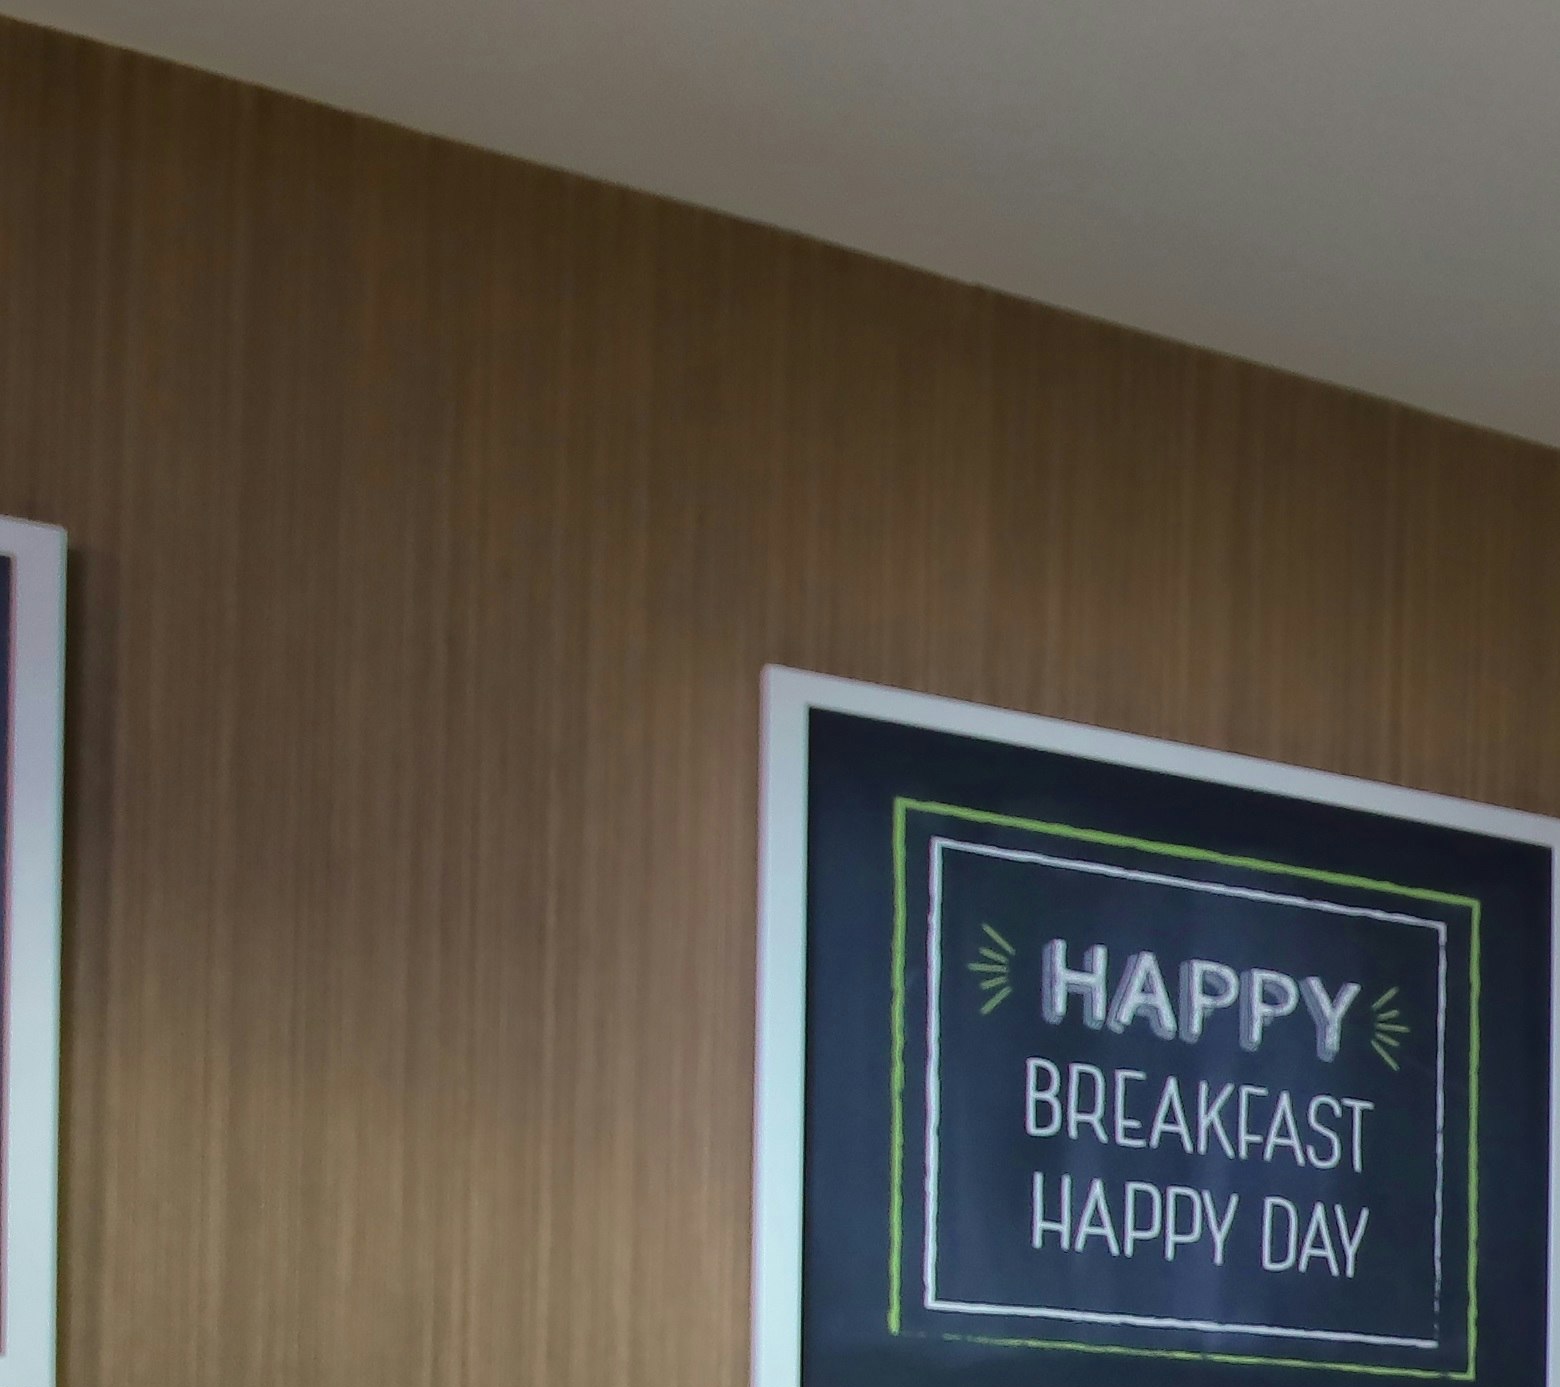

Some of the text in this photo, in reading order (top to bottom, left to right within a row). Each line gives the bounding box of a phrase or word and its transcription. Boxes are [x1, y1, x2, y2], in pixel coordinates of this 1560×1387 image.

[1042, 937, 1361, 1062] HAPPY
[1024, 1057, 1374, 1173] BREAKFAST
[1032, 1172, 1369, 1278] HAPPY DAY
